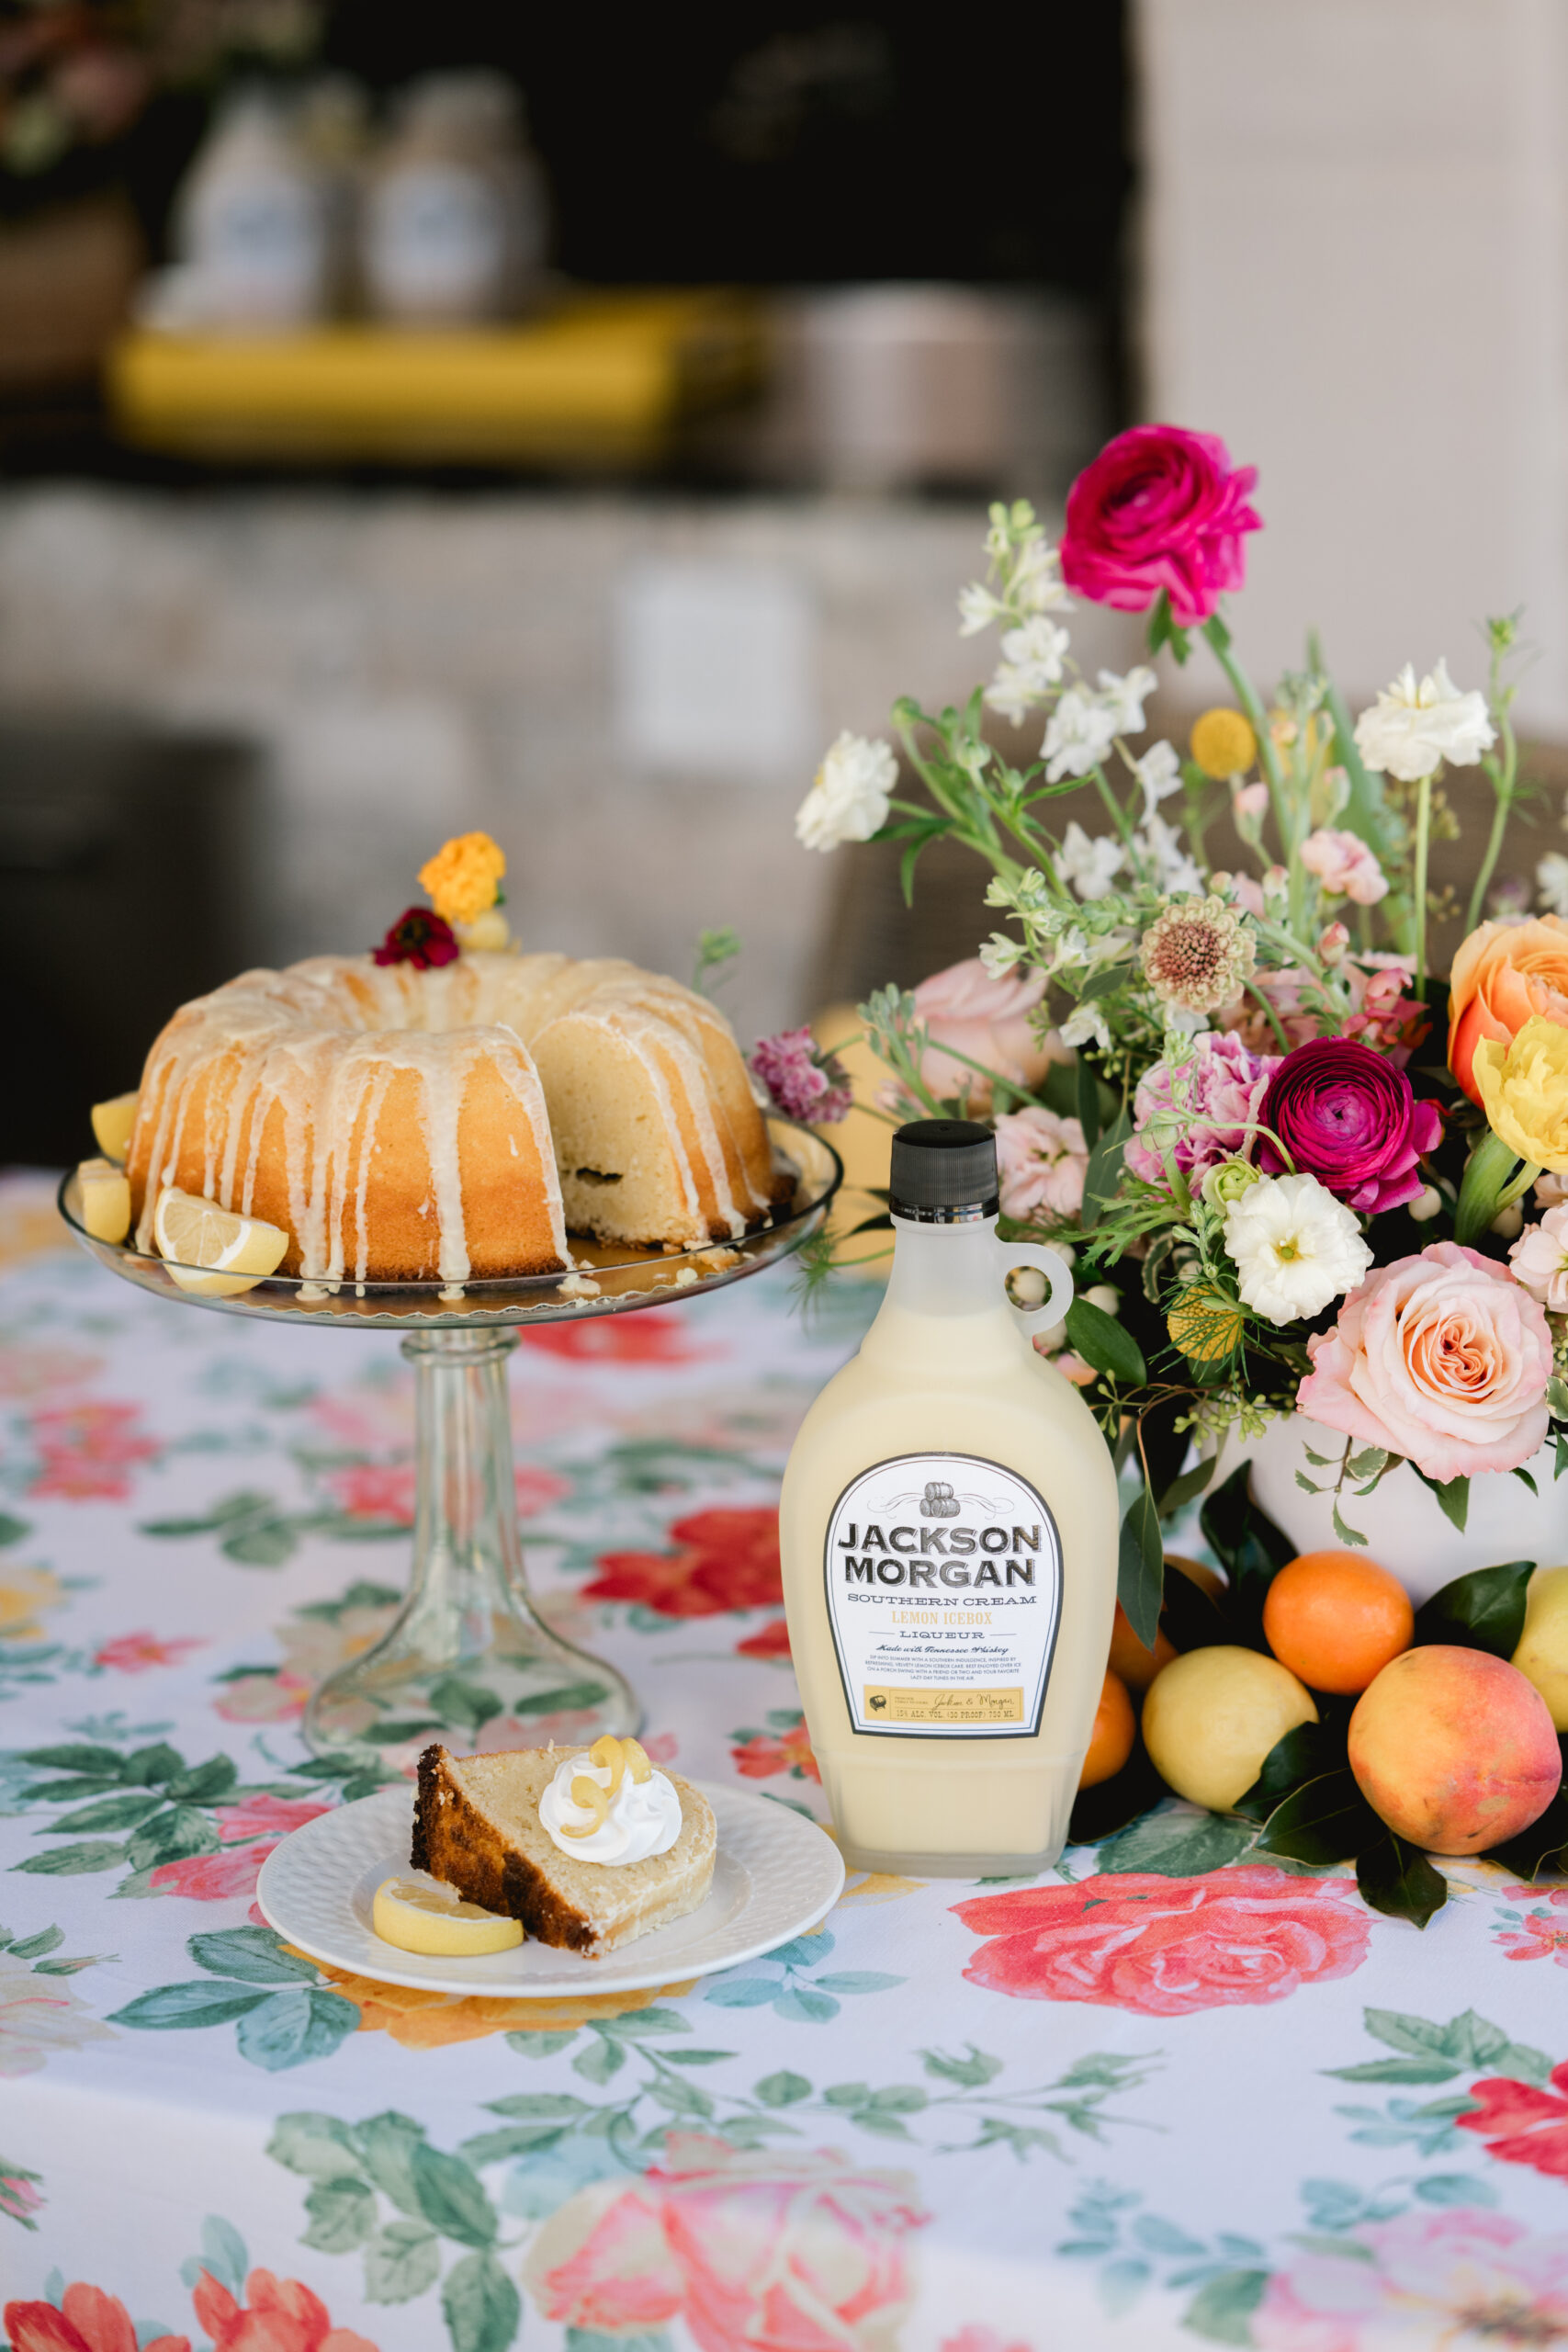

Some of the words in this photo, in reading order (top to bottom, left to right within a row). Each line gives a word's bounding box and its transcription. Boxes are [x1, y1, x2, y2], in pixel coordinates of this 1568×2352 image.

[838, 1522, 1043, 1555] JACKSON
[844, 1555, 1037, 1589] MORGAN
[847, 1593, 959, 1606] SOUTHERN
[963, 1596, 1037, 1606] CREAM
[891, 1611, 938, 1624] LEMON
[943, 1611, 993, 1625] ICEBOX
[899, 1631, 985, 1639] LIQUEUR
[875, 1644, 902, 1652] Made
[924, 1645, 969, 1654] Tennessee
[971, 1645, 1010, 1656] Whiskey
[1003, 1710, 1015, 1718] ML
